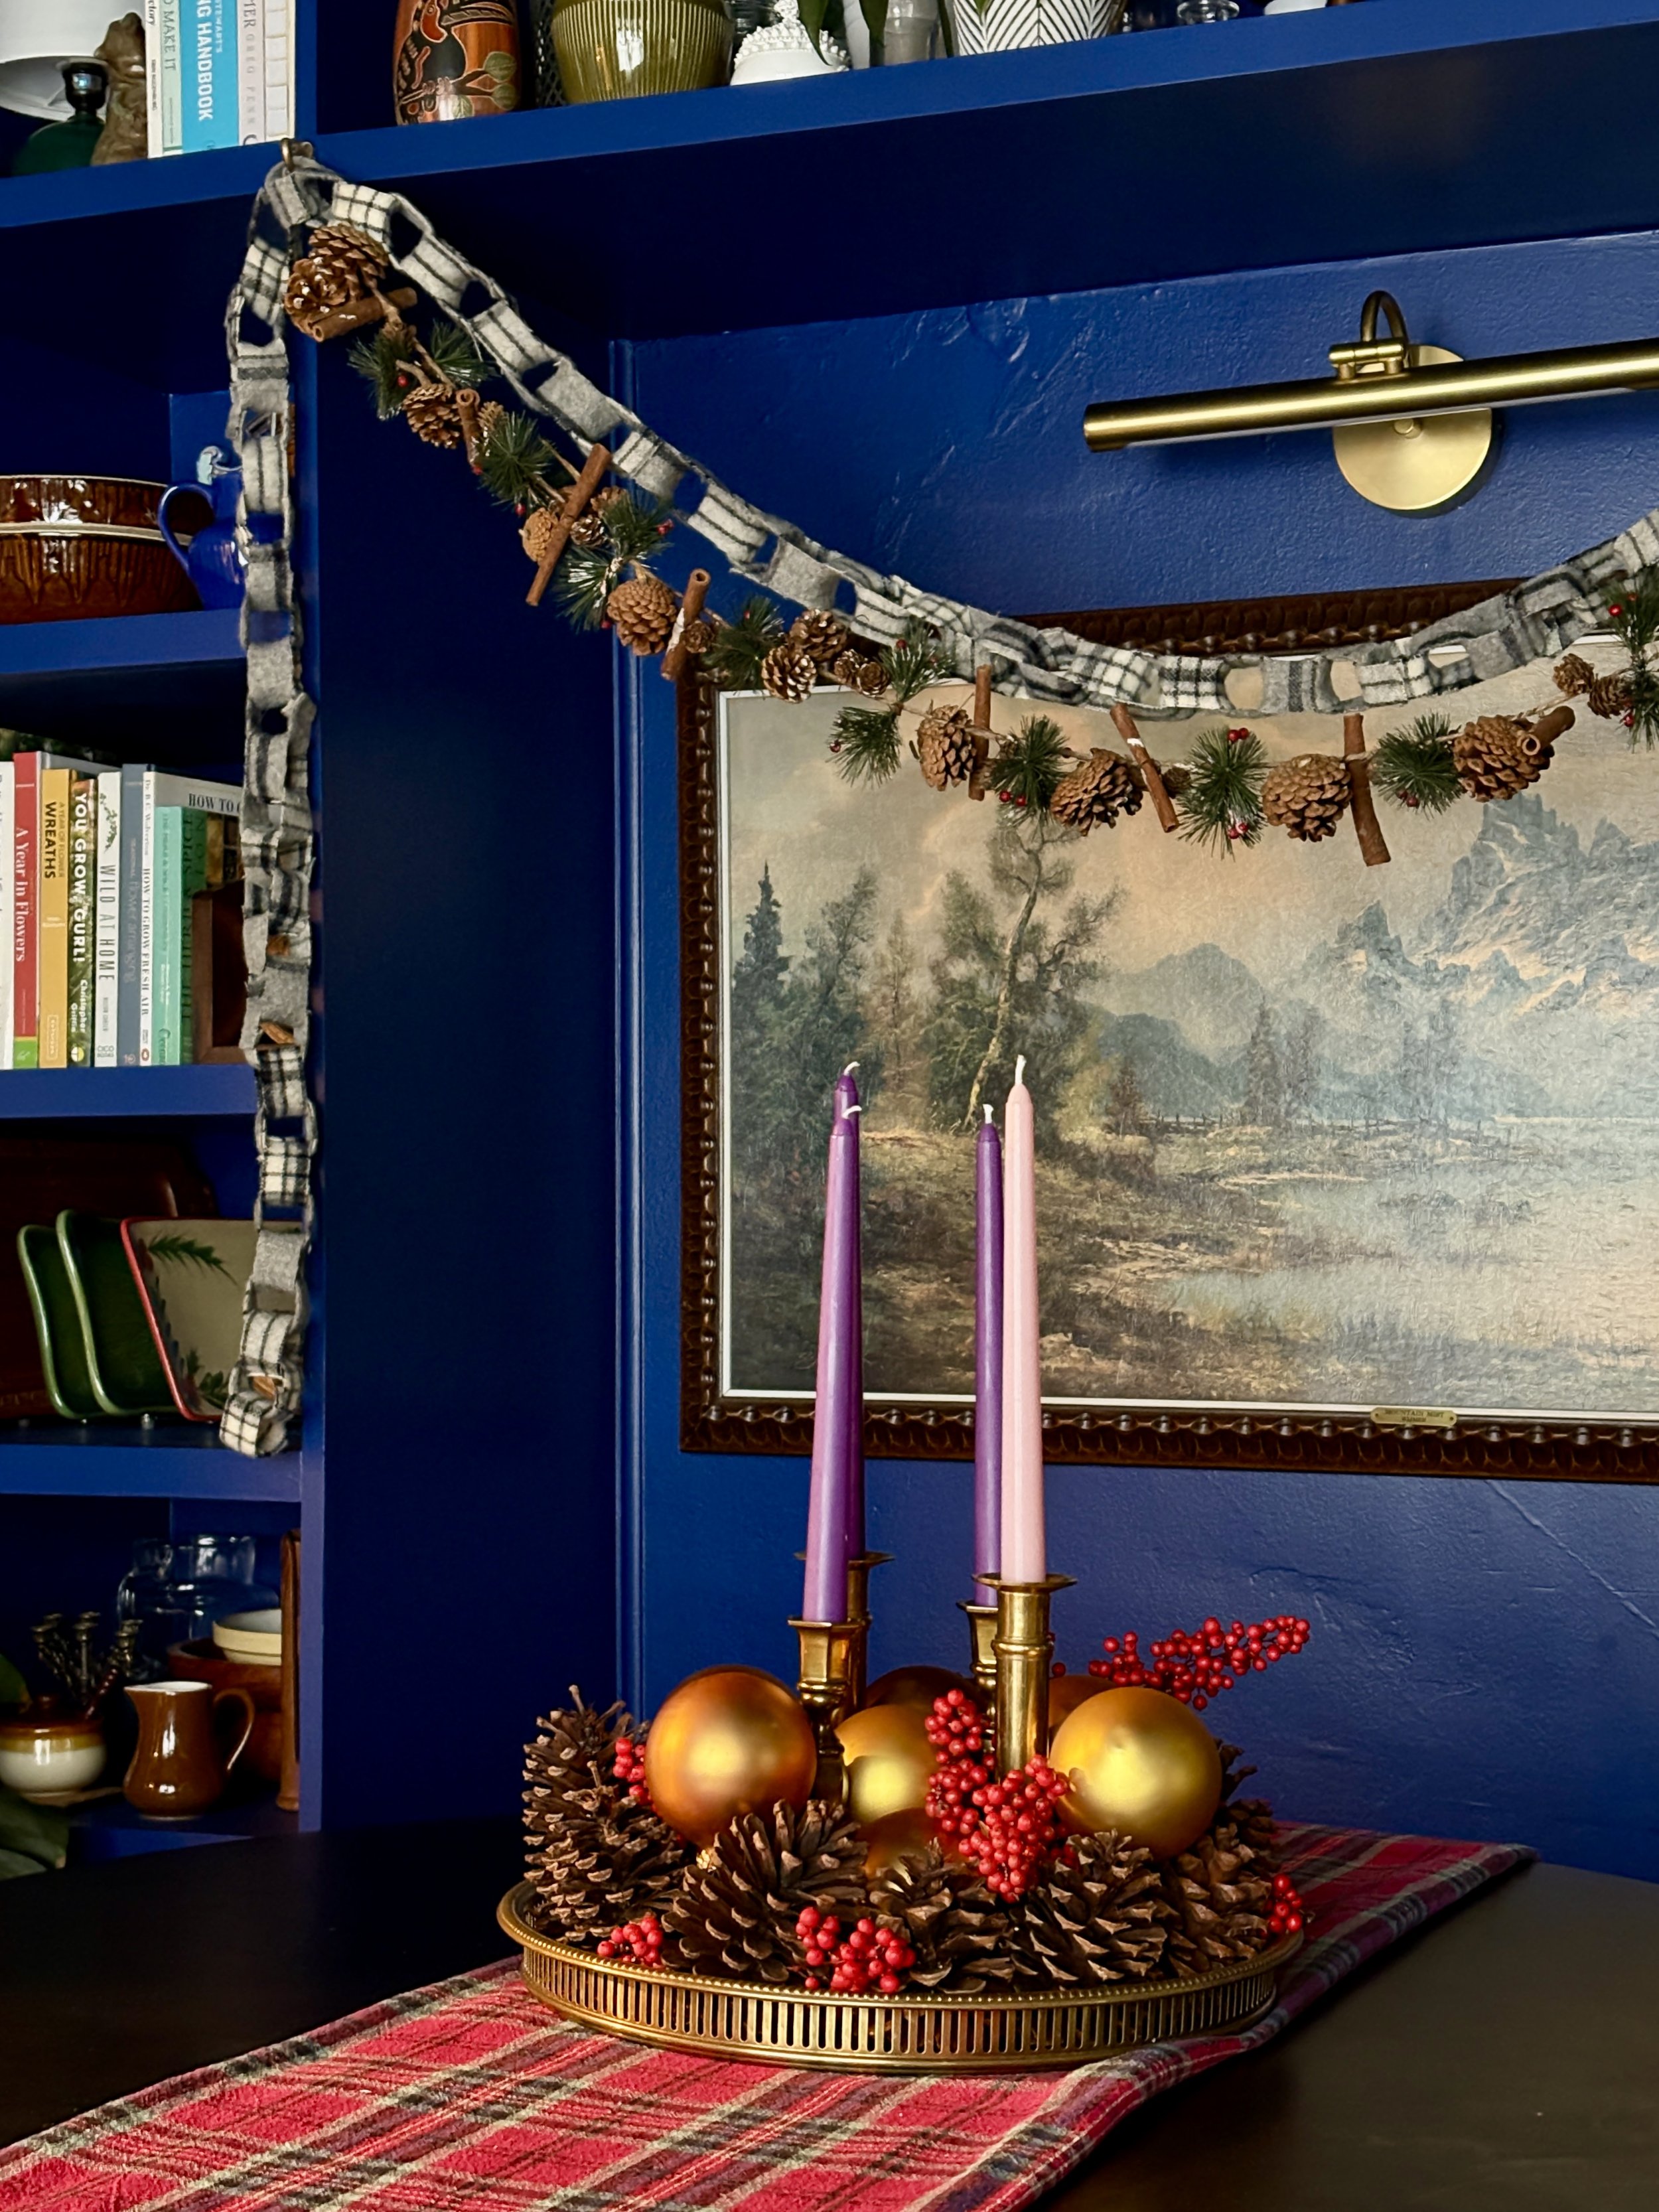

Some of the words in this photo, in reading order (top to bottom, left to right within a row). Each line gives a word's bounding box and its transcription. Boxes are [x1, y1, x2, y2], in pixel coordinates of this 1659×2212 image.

[163, 11, 175, 52] MAKE
[164, 58, 176, 71] IT
[197, 21, 213, 121] HANDBOOK
[75, 792, 87, 832] YOU
[188, 793, 214, 810] HOW
[219, 798, 234, 812] TO
[16, 828, 29, 837] A
[44, 802, 57, 879] WREATHS
[16, 842, 29, 877] Year
[15, 881, 28, 896] In
[100, 865, 115, 903] WILD
[100, 914, 115, 929] AT
[143, 899, 151, 913] TO
[15, 901, 29, 962] Flowers
[72, 908, 87, 962] GURL!
[99, 939, 115, 980] HOME
